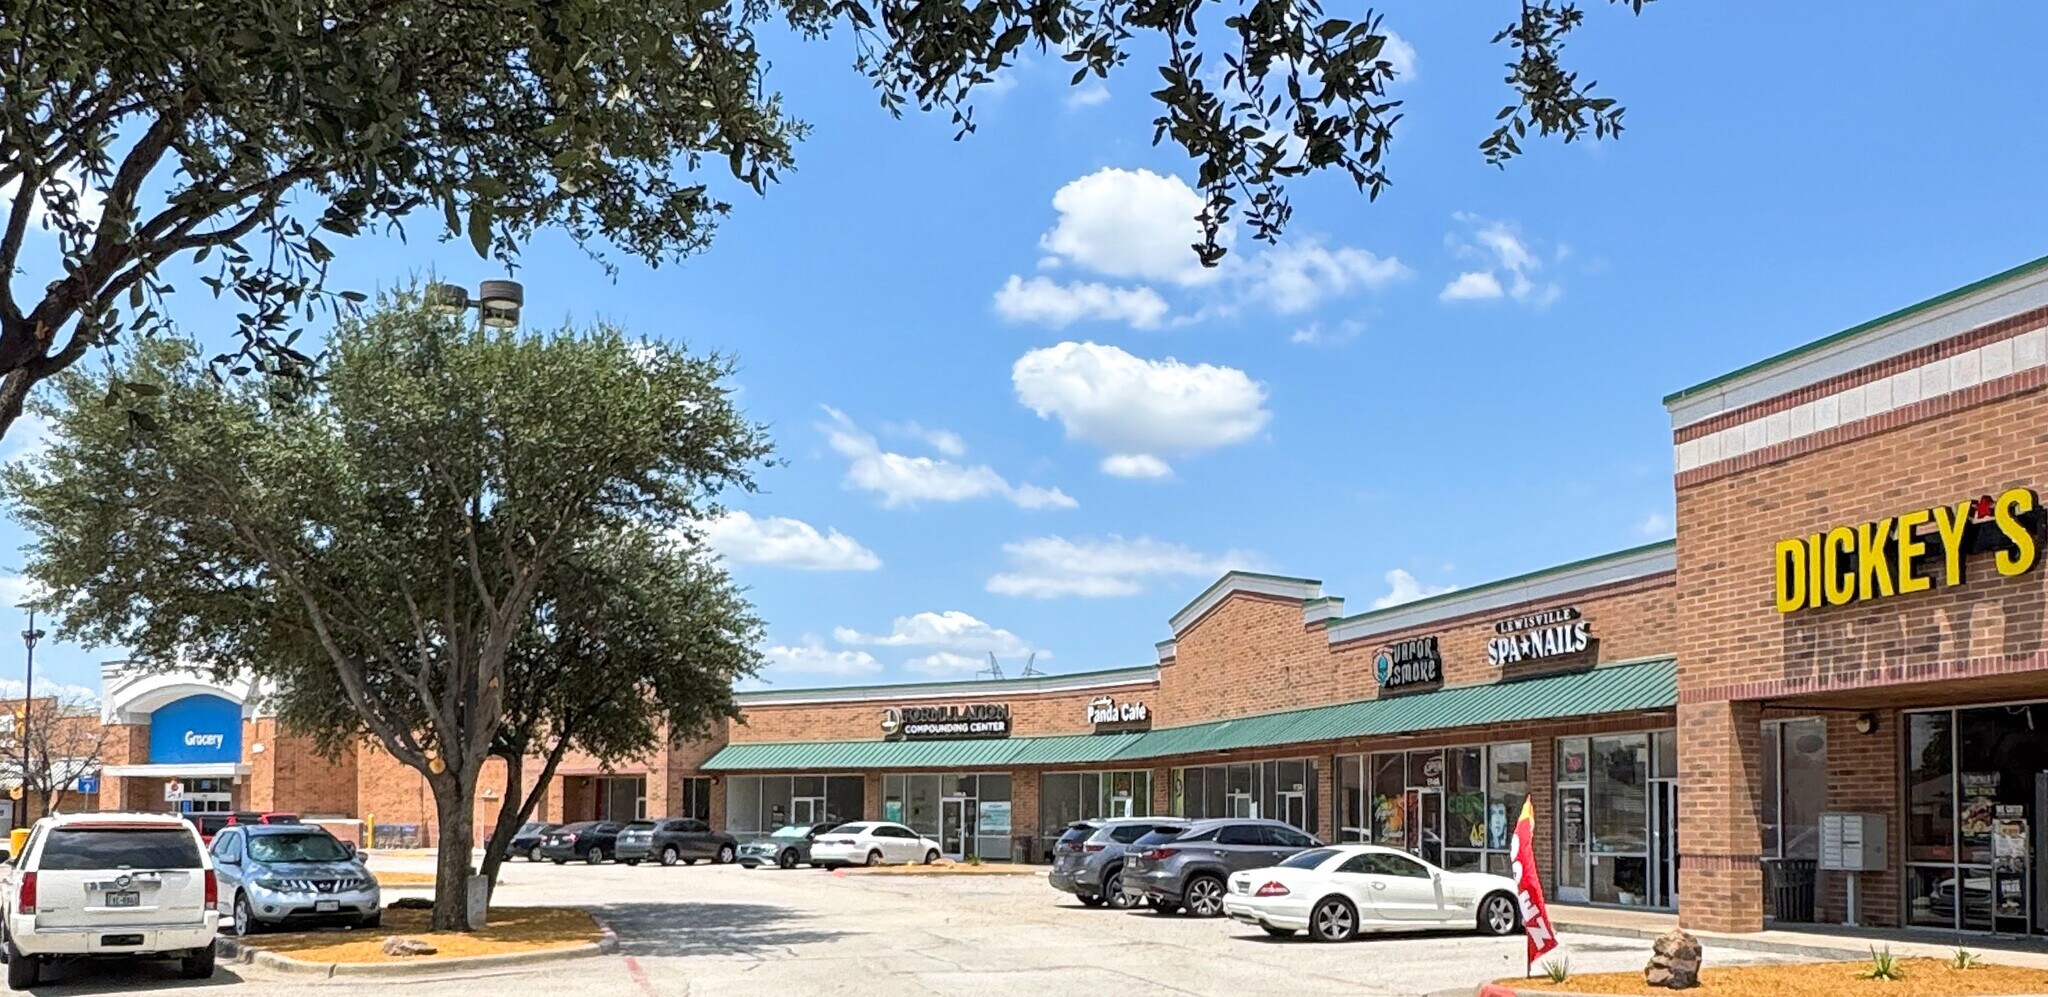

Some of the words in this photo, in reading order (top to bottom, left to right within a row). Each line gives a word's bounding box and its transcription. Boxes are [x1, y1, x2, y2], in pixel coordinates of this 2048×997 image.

[1775, 487, 2035, 613] DICKEY'S
[1500, 608, 1571, 633] LEWISVILLE
[901, 703, 1009, 722] FORMULATION
[1087, 703, 1119, 724] Panda
[1121, 701, 1147, 722] Cafe
[904, 722, 968, 734] COMPOUNDING
[970, 721, 1005, 732] CENTER
[184, 730, 224, 750] Grocery
